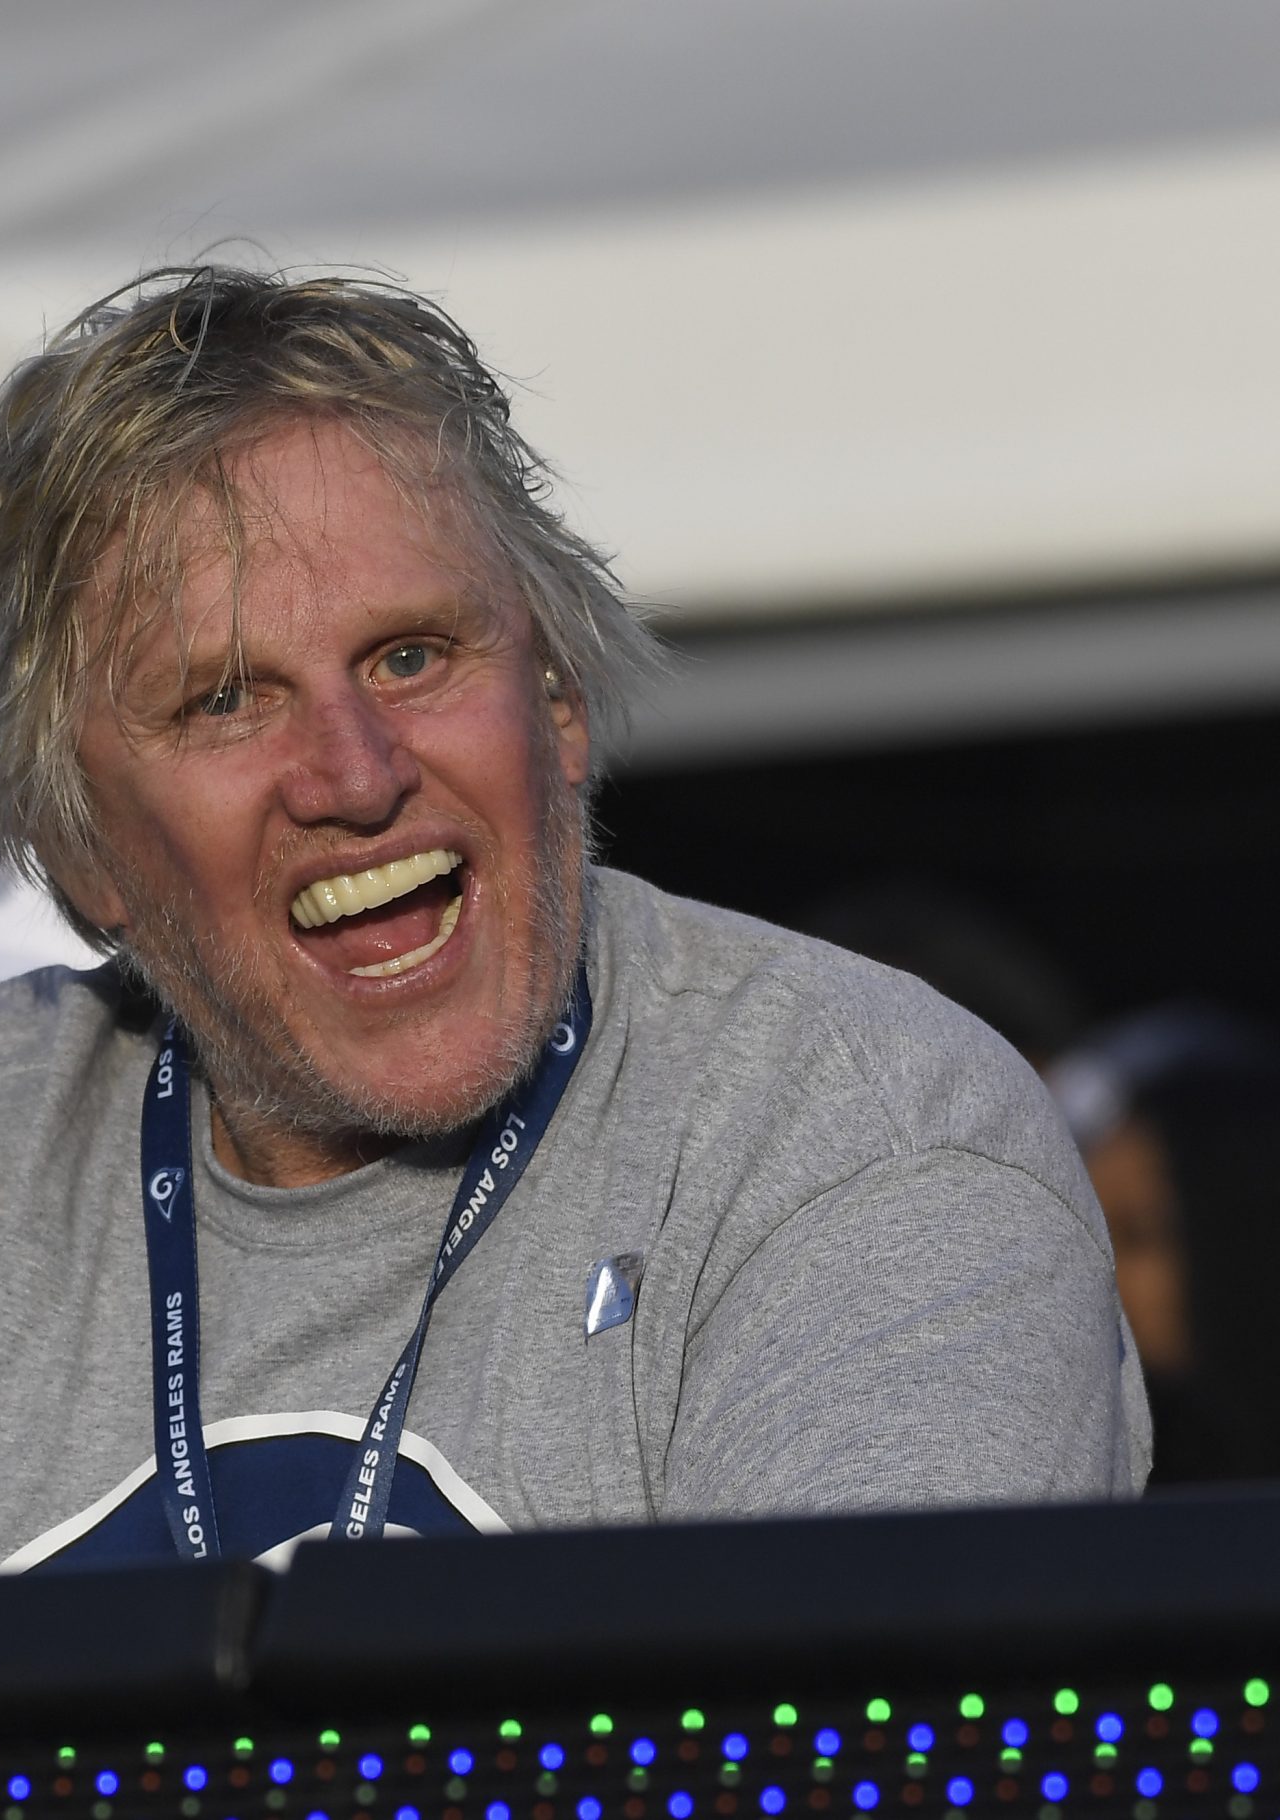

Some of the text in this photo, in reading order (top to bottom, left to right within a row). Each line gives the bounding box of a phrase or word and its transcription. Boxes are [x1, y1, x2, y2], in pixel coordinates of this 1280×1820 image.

[157, 1048, 173, 1099] LOS
[435, 1112, 526, 1280] LOS ANGEL
[167, 1291, 208, 1559] LOS ANGELES RAMS
[346, 1363, 407, 1540] GELES RAMS
